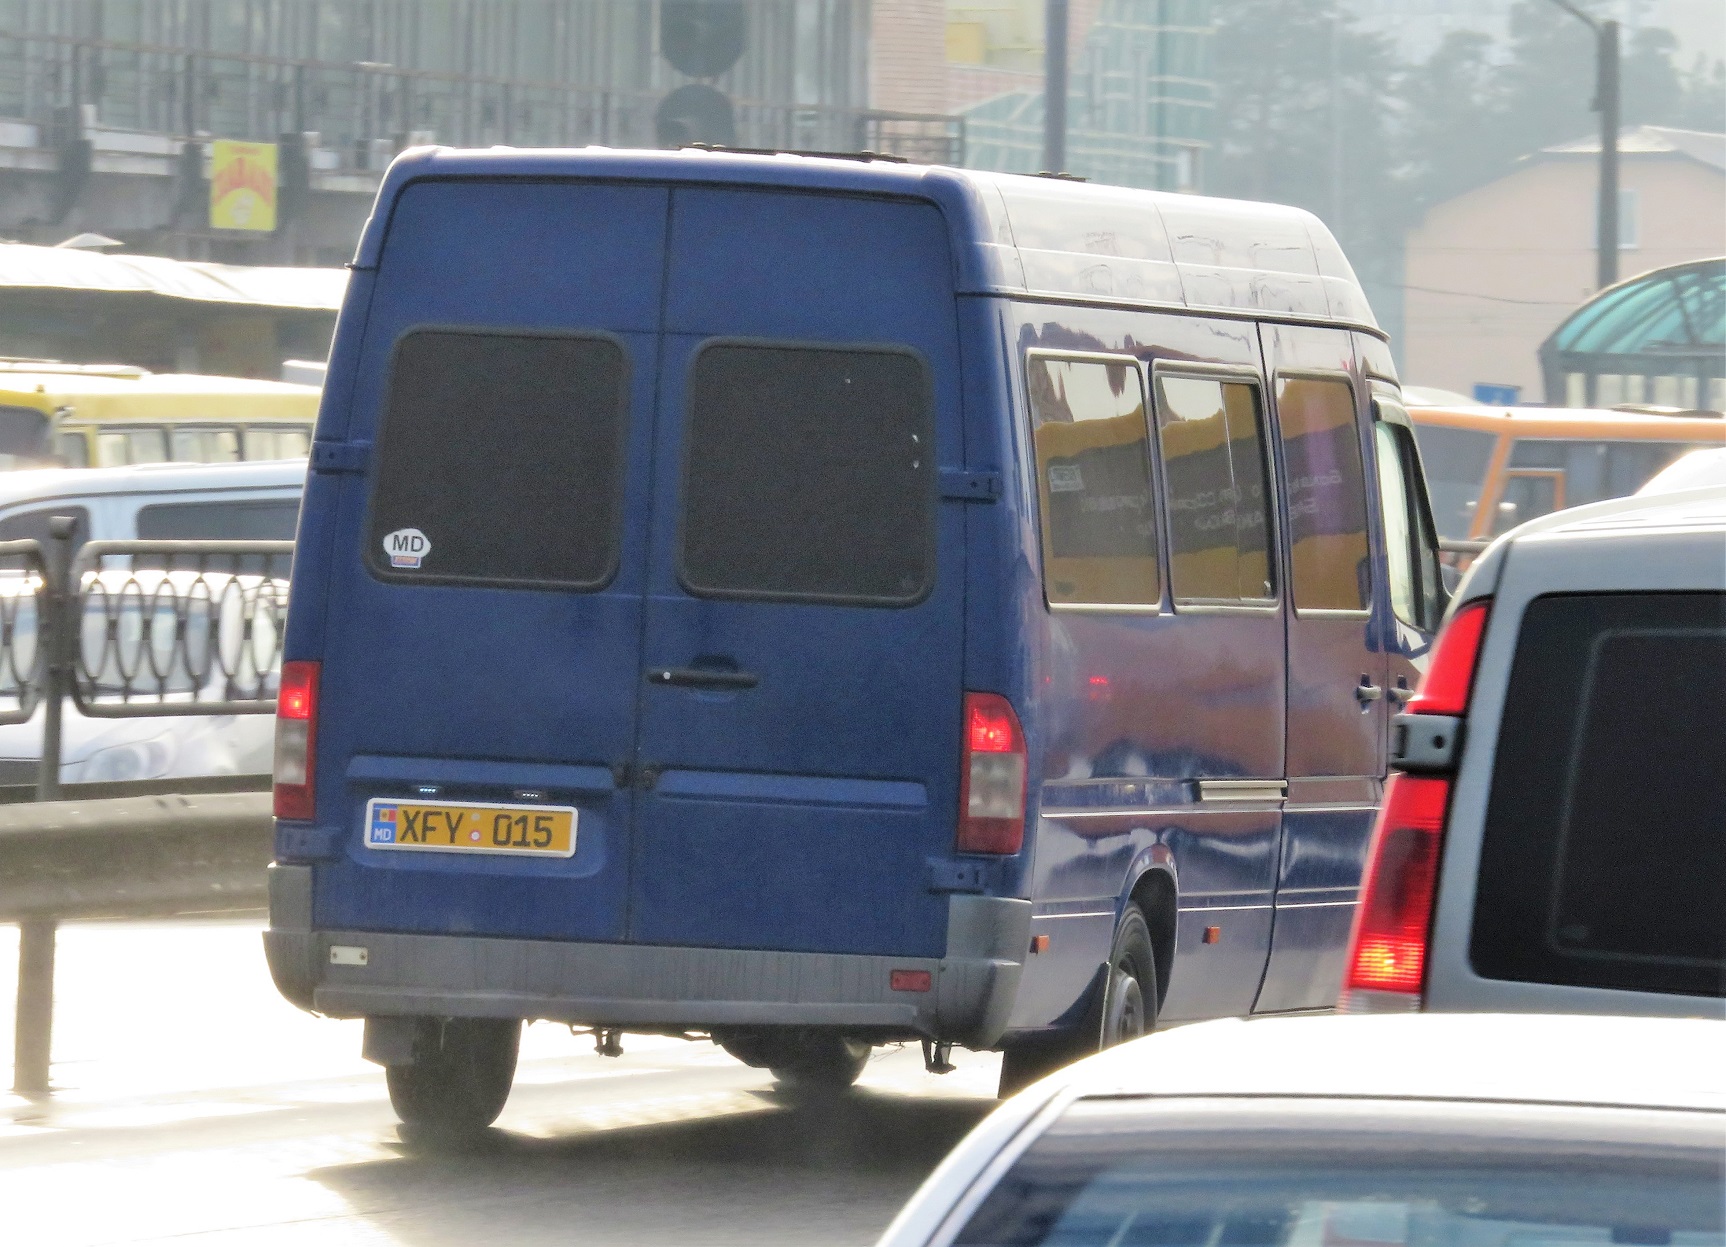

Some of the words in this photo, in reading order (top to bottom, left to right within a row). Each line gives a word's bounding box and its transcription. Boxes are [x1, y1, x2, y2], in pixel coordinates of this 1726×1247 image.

[392, 534, 424, 552] MD
[373, 827, 392, 842] MD
[400, 809, 464, 843] XFY
[492, 813, 554, 848] 015
